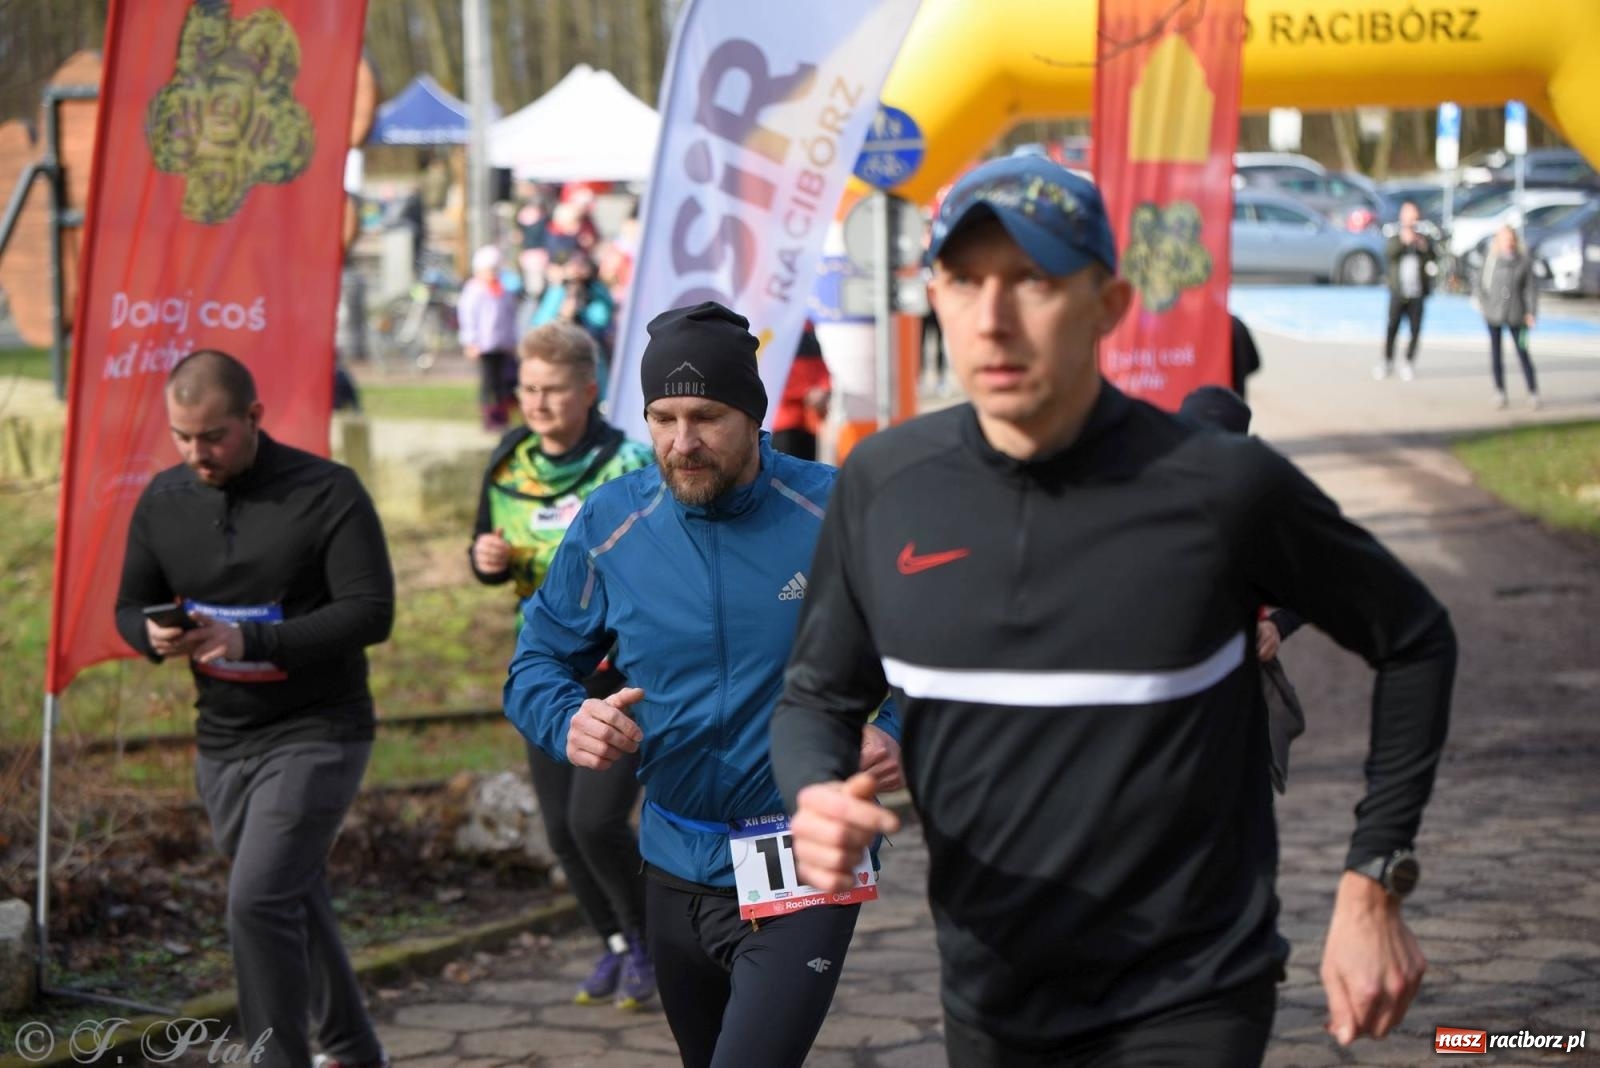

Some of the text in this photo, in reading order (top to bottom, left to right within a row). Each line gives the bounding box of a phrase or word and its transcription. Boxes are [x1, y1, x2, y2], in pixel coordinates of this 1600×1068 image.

[1269, 6, 1482, 45] RACIBÓRZ
[670, 38, 818, 308] SiR
[764, 74, 864, 304] RACIBÓRZ
[198, 296, 267, 331] coś
[744, 817, 759, 828] XII
[761, 813, 785, 824] BIEG
[785, 896, 826, 911] Racibórz
